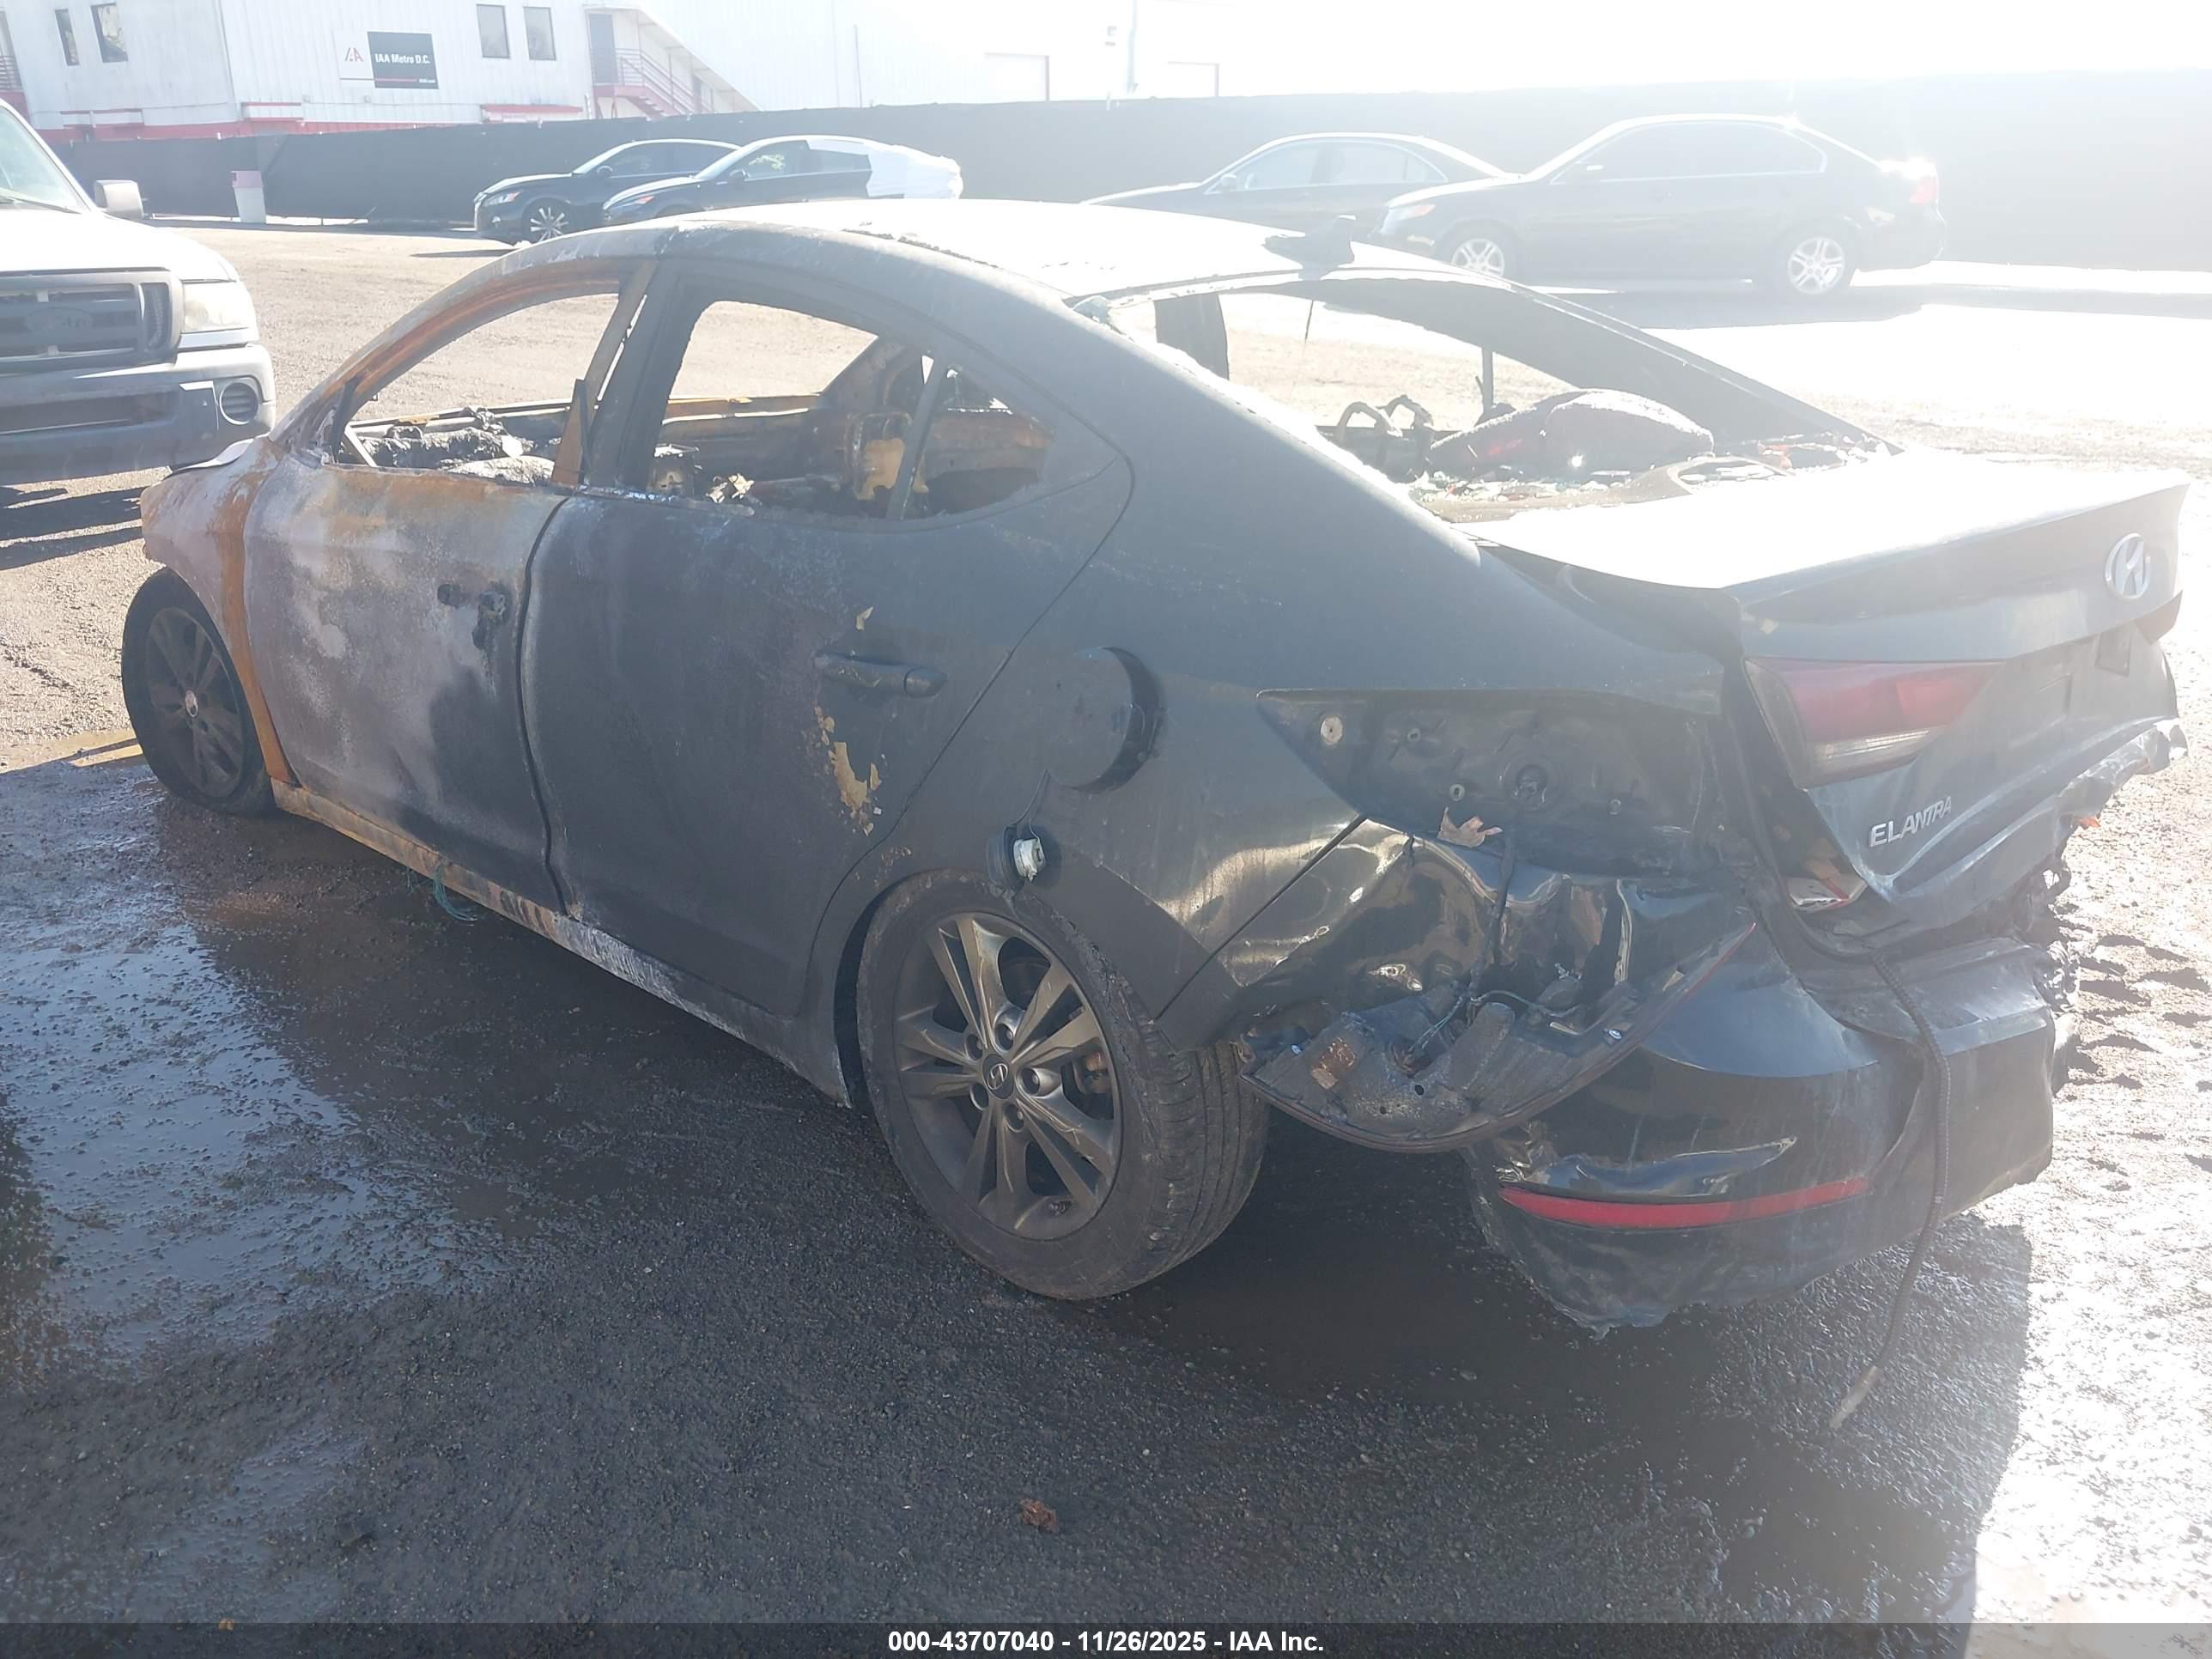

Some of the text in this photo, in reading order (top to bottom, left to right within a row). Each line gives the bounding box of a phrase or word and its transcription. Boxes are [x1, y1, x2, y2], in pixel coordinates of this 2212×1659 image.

[374, 53, 430, 64] IAA Metro D.C.
[1869, 796, 1951, 848] ELANTRA
